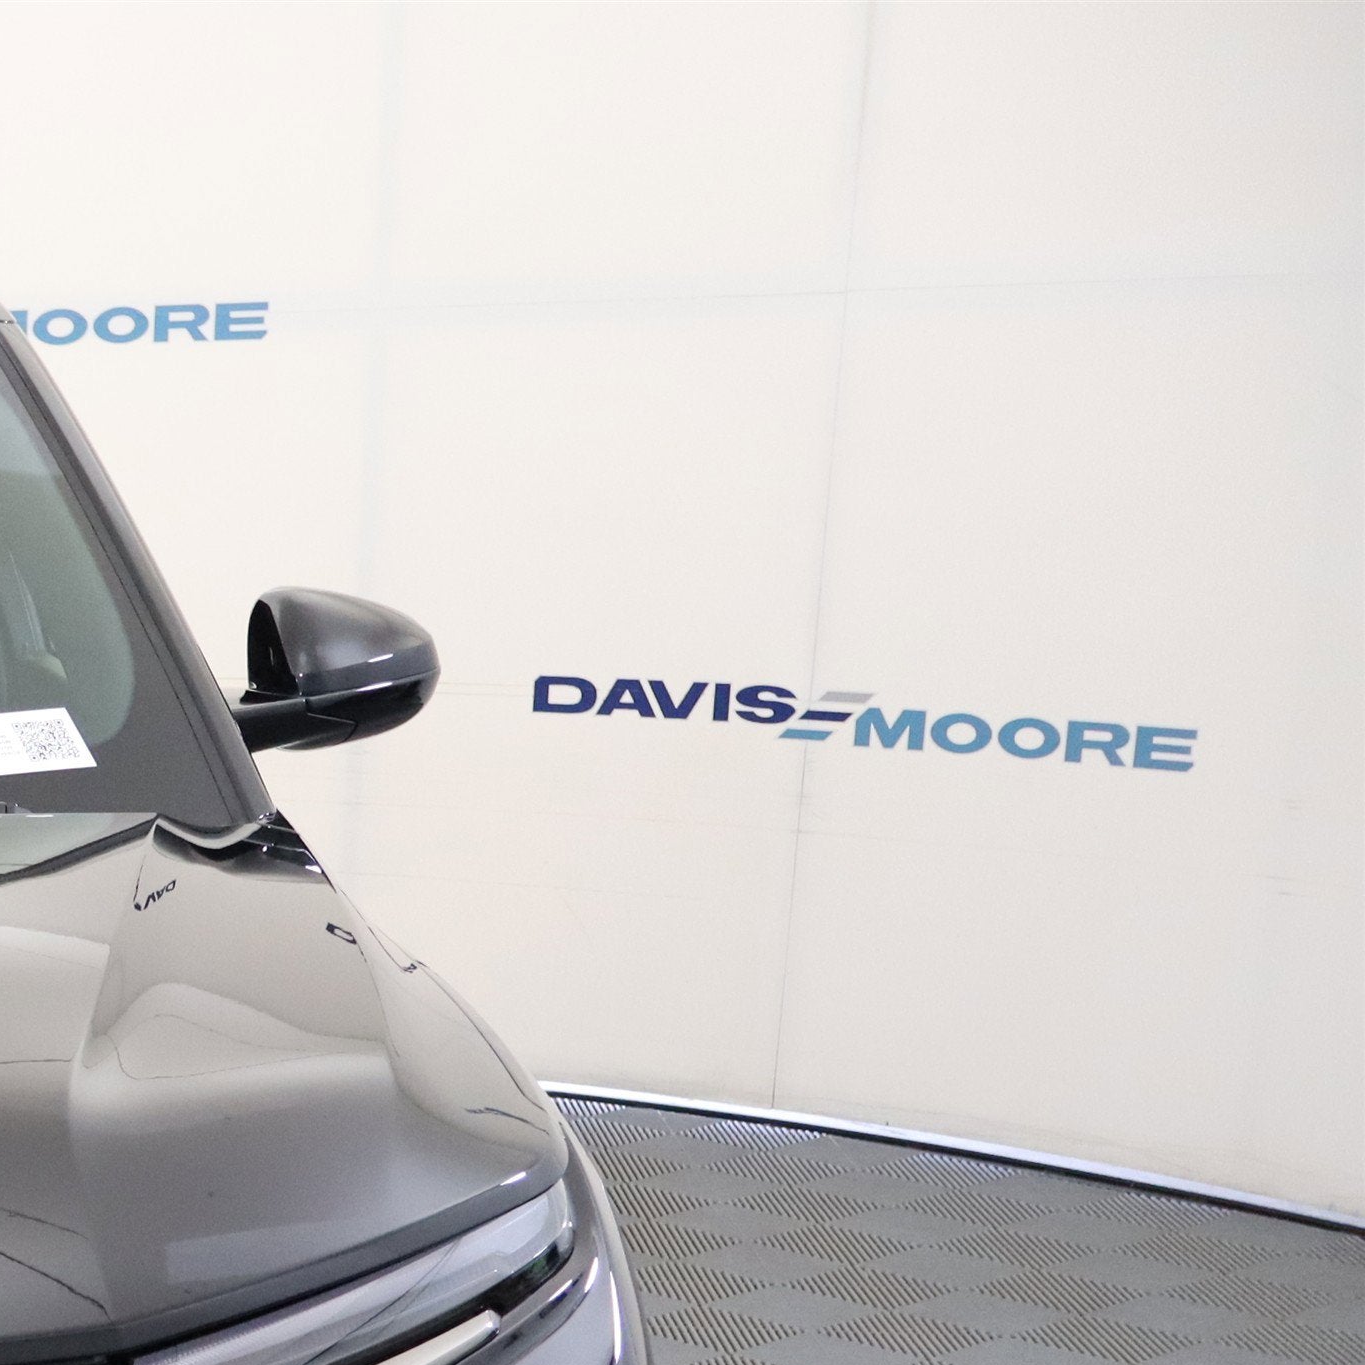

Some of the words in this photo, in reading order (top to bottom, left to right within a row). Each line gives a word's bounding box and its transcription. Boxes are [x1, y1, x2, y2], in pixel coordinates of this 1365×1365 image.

[9, 301, 269, 345] OORE
[532, 675, 798, 724] DAVIS
[853, 706, 1198, 772] MOORE
